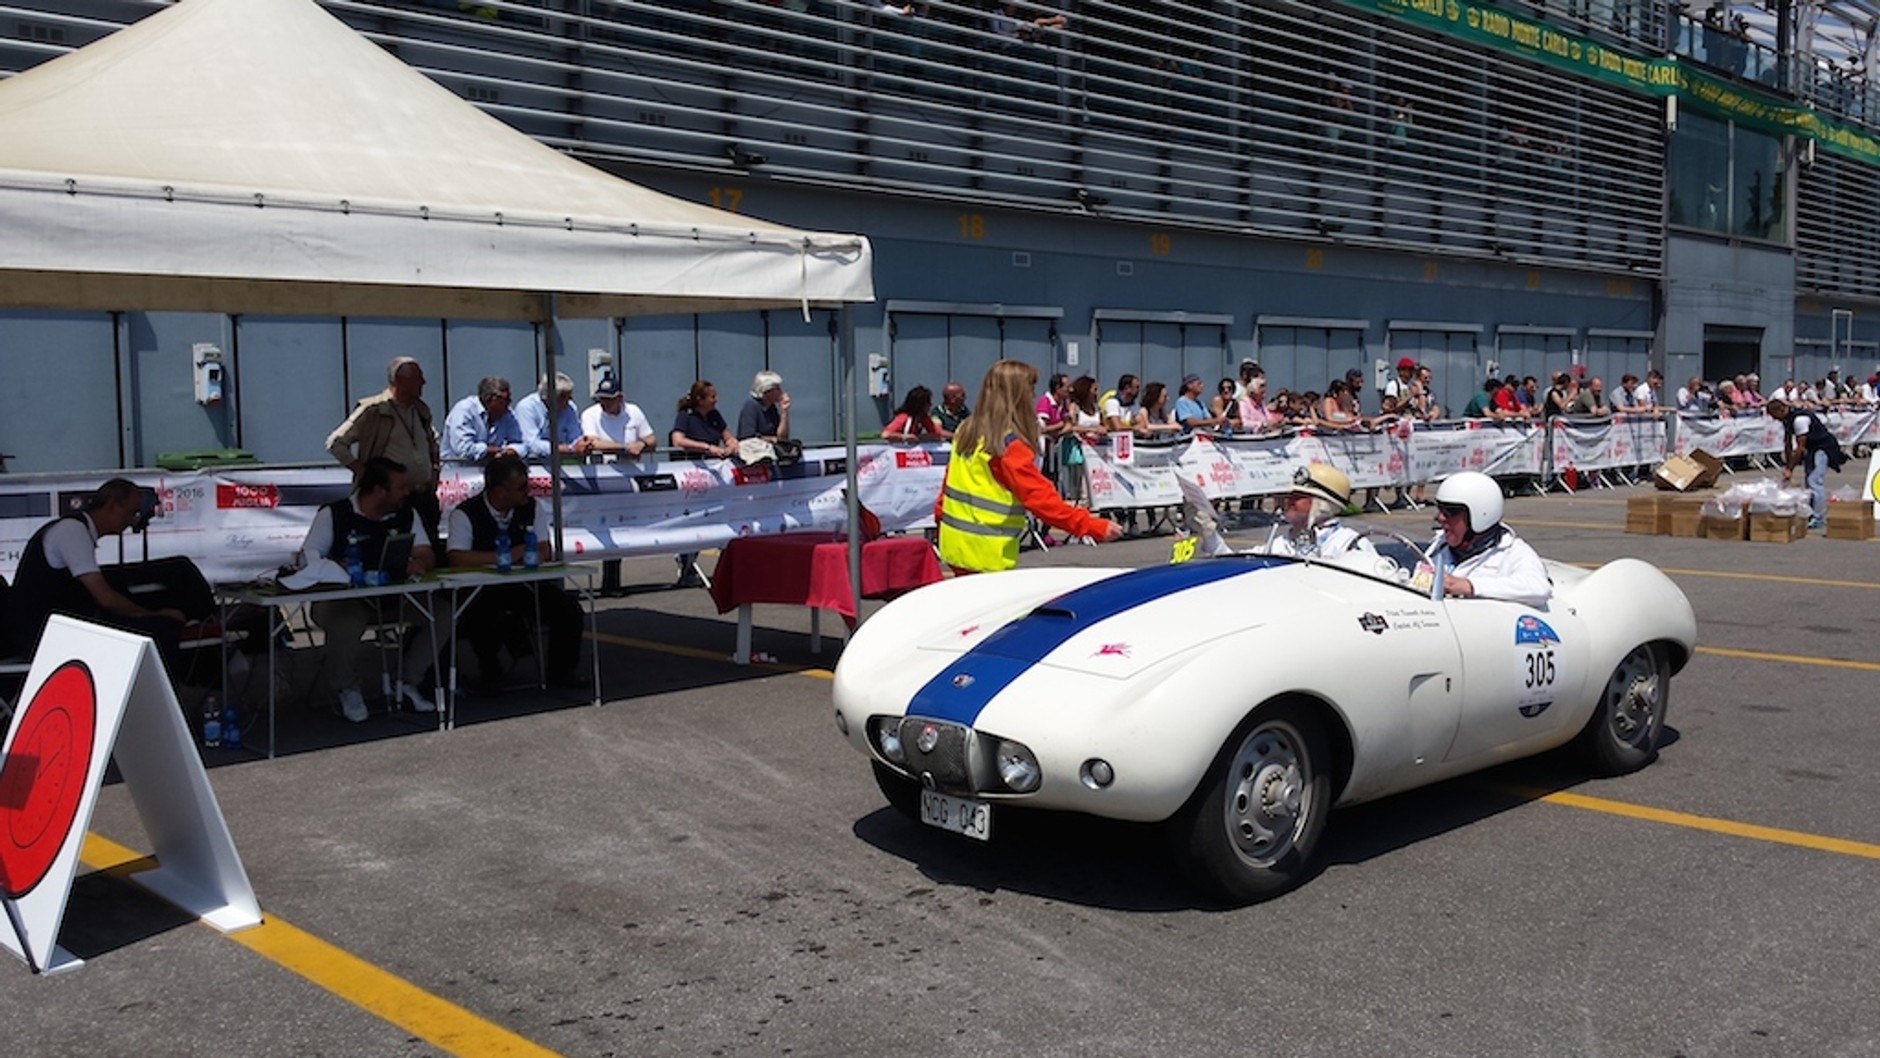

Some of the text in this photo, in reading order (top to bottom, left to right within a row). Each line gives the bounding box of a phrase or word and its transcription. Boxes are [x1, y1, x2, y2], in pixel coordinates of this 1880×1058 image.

[1481, 9, 1569, 58] RADIO MONTE CARLO
[1599, 47, 1622, 73] RADIO
[709, 187, 742, 212] 17
[958, 214, 985, 240] 18
[1150, 233, 1171, 257] 19
[176, 486, 205, 499] 2016
[234, 485, 269, 497] 1000
[1525, 650, 1556, 689] 305
